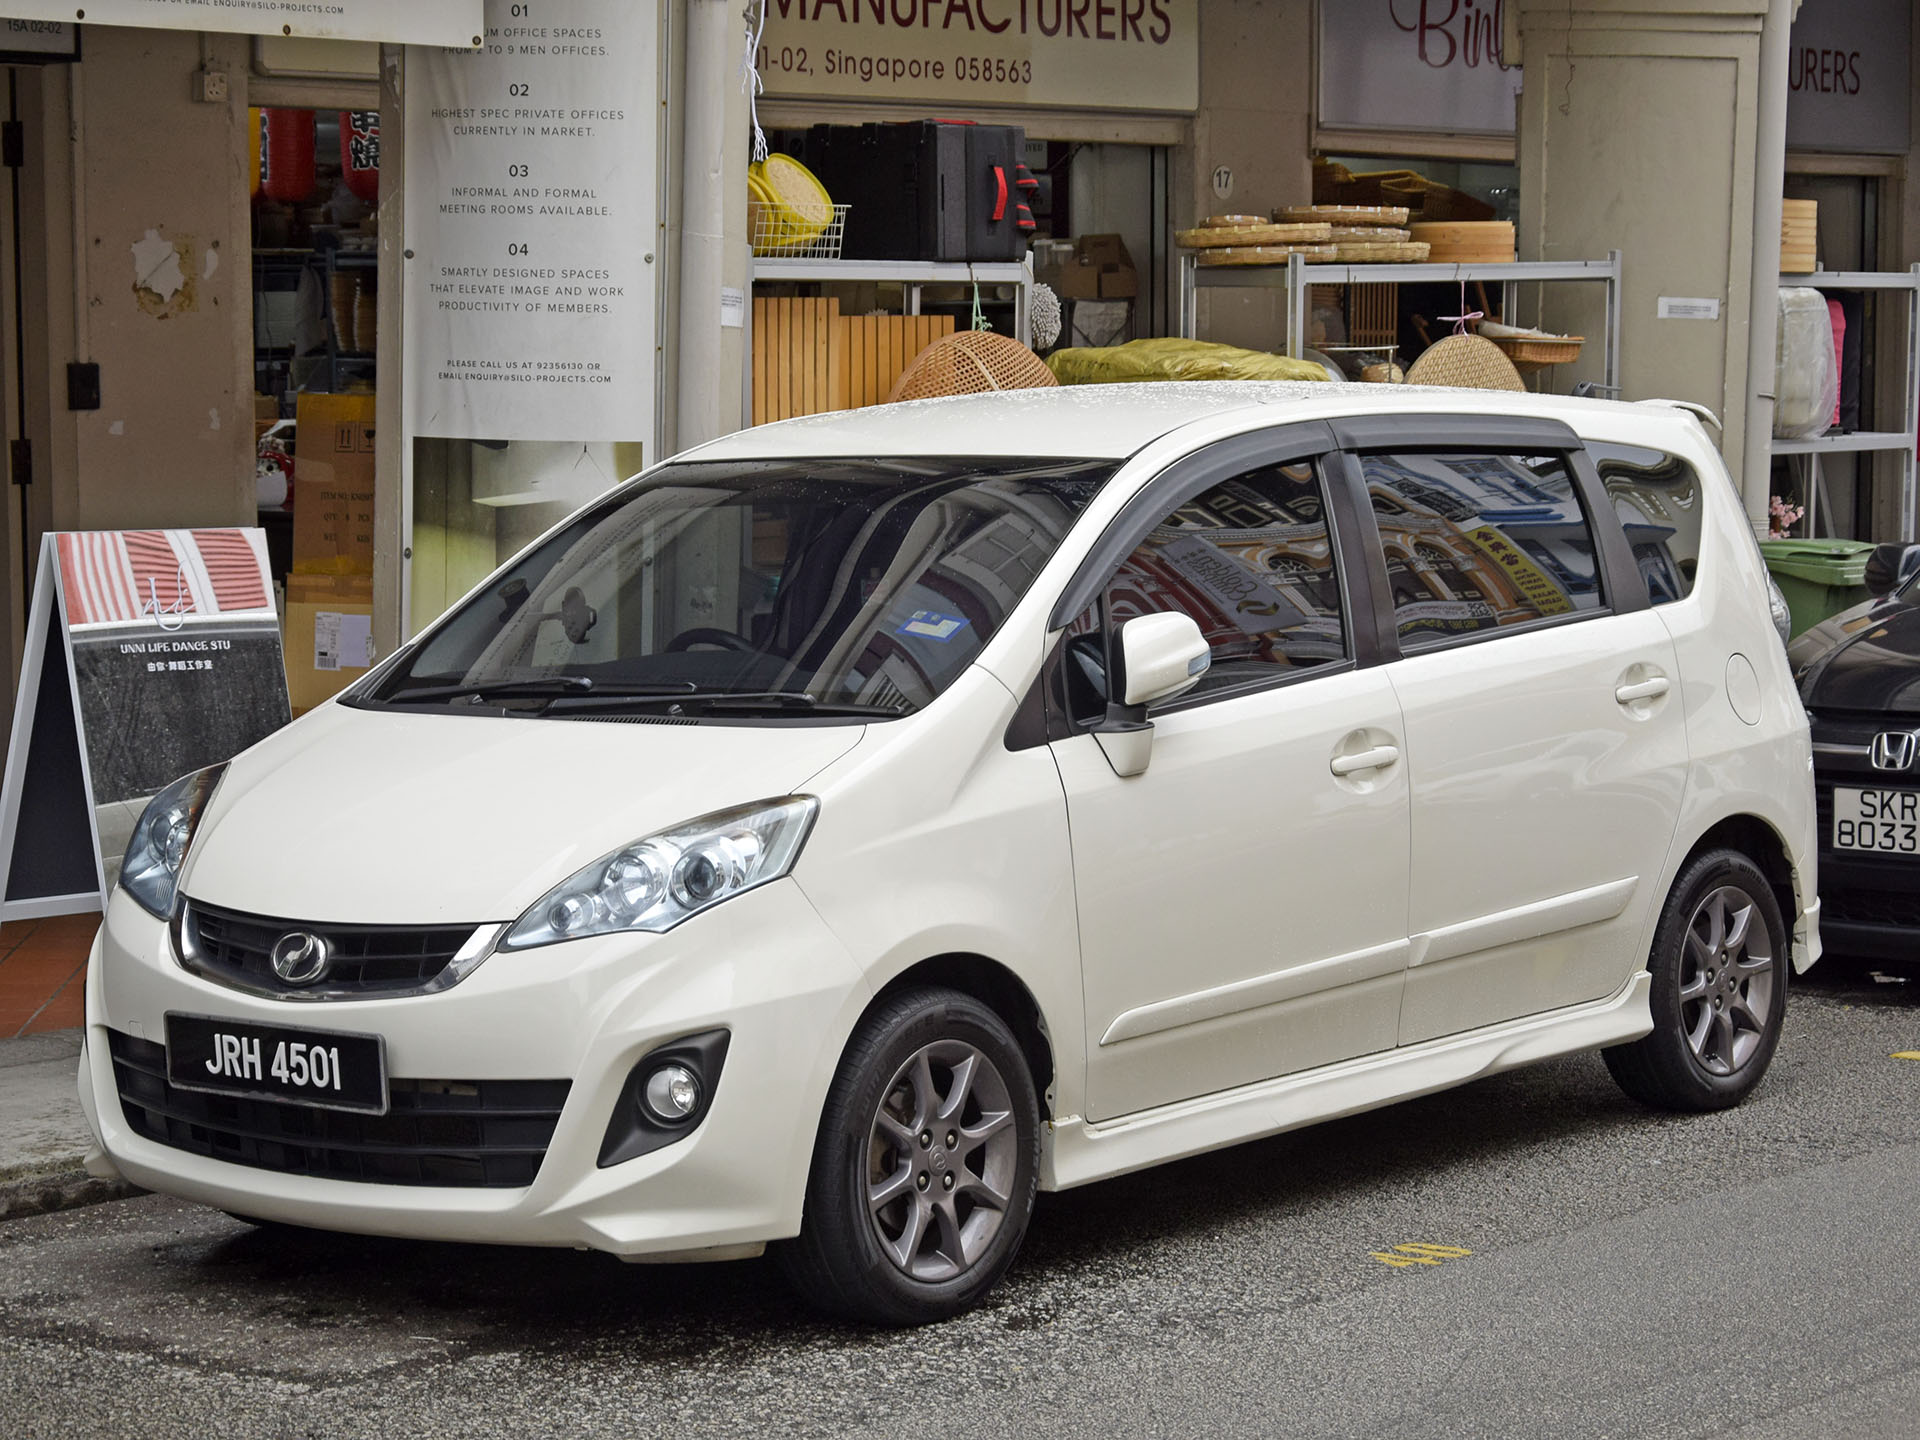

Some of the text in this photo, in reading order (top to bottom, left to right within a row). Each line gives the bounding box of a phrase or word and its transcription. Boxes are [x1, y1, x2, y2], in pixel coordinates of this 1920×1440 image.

[213, 0, 345, 15] ENQUIRY@SILO-PROJECTS.COM
[511, 4, 529, 17] 01
[8, 19, 63, 34] 15A 02-02
[503, 28, 548, 38] OFFICE
[553, 29, 602, 40] SPACES
[488, 45, 503, 55] TO
[508, 45, 515, 55] 9
[520, 45, 546, 55] MEN
[551, 46, 610, 56] OFFICES.
[825, 49, 945, 83] Singapore
[955, 56, 1033, 84] 058563
[509, 83, 529, 97] 02
[431, 108, 625, 120] HIGHEST SPEC PRIVATE OFFICES
[453, 126, 596, 137] CURRENTLY IN MARKET.
[508, 164, 529, 178] 03
[1215, 170, 1231, 188] 17
[451, 187, 597, 199] INFORMAL AND FORMAL
[439, 204, 613, 217] MEETING ROOMS AVAILABLE.
[507, 243, 529, 257] 04
[441, 267, 610, 280] SMARTLY DESIGNED SPACES
[430, 283, 625, 297] THAT ELEVATE IMAGE AND WORK
[438, 301, 613, 314] PRODUCTIVITY OF MEMBERS.
[446, 360, 601, 371] PLEASE CALL US AT 92356130 OR
[438, 372, 612, 384] EMAIL ENQUIRY@SILO-PROJECTS.COM
[120, 639, 231, 654] UNNI LIFE DANCE STU
[1860, 790, 1918, 821] SKR
[1838, 819, 1917, 852] 8033
[205, 1033, 341, 1091] JRH 4501
